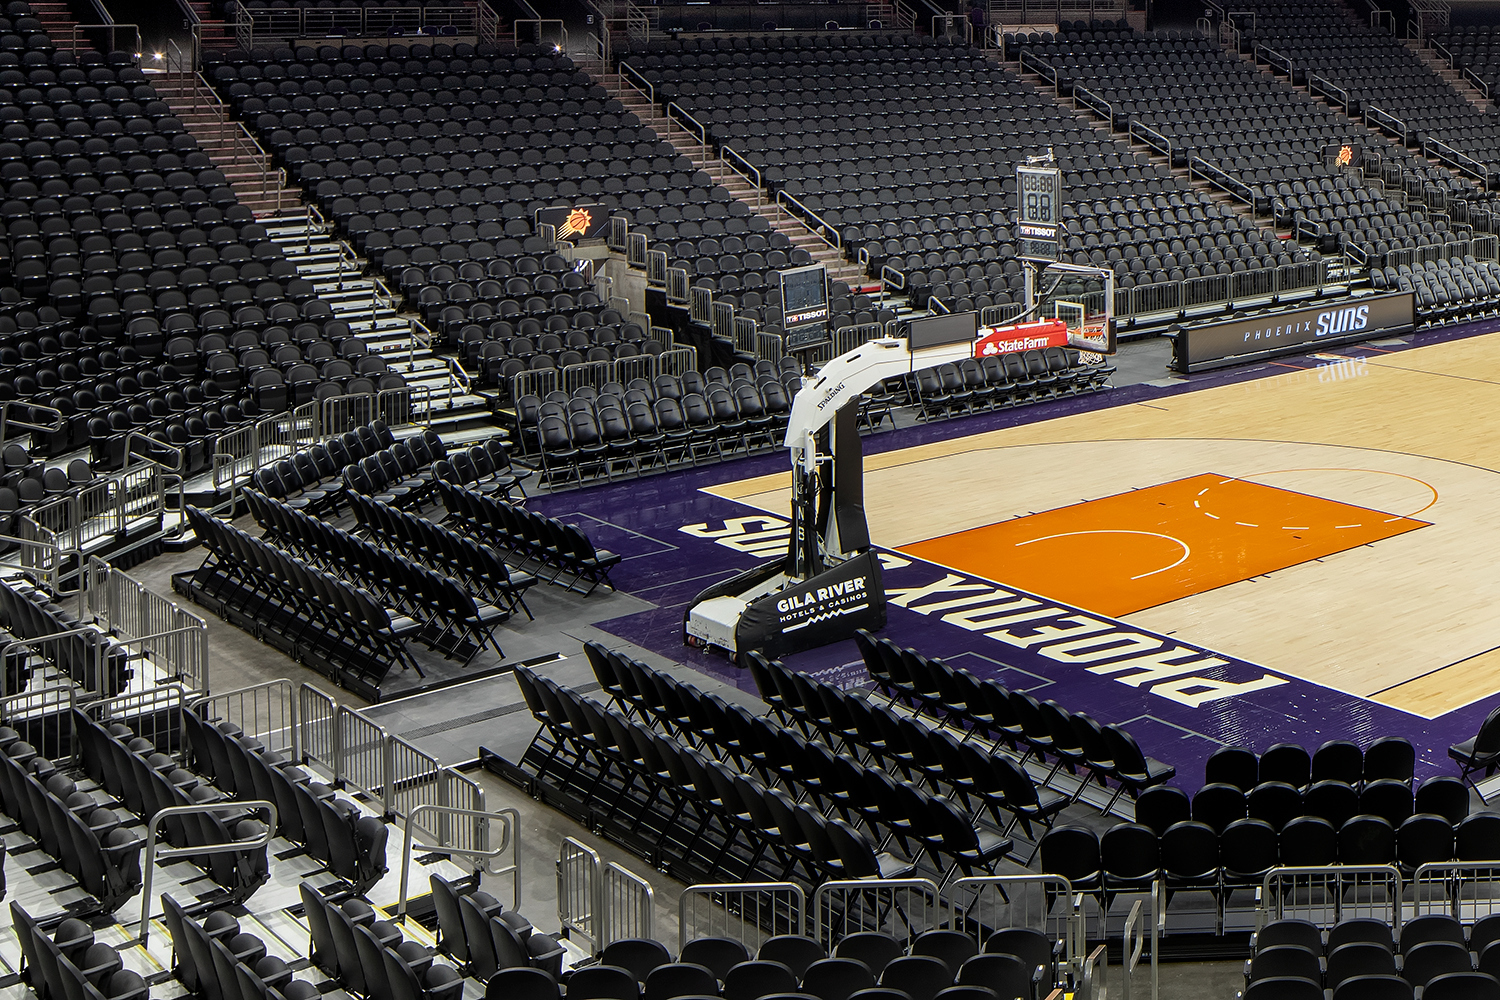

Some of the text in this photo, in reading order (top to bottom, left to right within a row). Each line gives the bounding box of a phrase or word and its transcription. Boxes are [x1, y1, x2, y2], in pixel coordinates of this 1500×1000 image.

[1030, 228, 1056, 238] TISSOT
[800, 309, 827, 321] TISSOT
[1244, 305, 1369, 342] PHOENIX SUNS
[998, 337, 1049, 353] StateFarm
[817, 382, 846, 411] SPALDING
[776, 577, 866, 614] GILA RIVER
[779, 606, 814, 623] HOTELS
[828, 591, 868, 609] CASINOS
[886, 573, 1290, 709] PHOENIX
